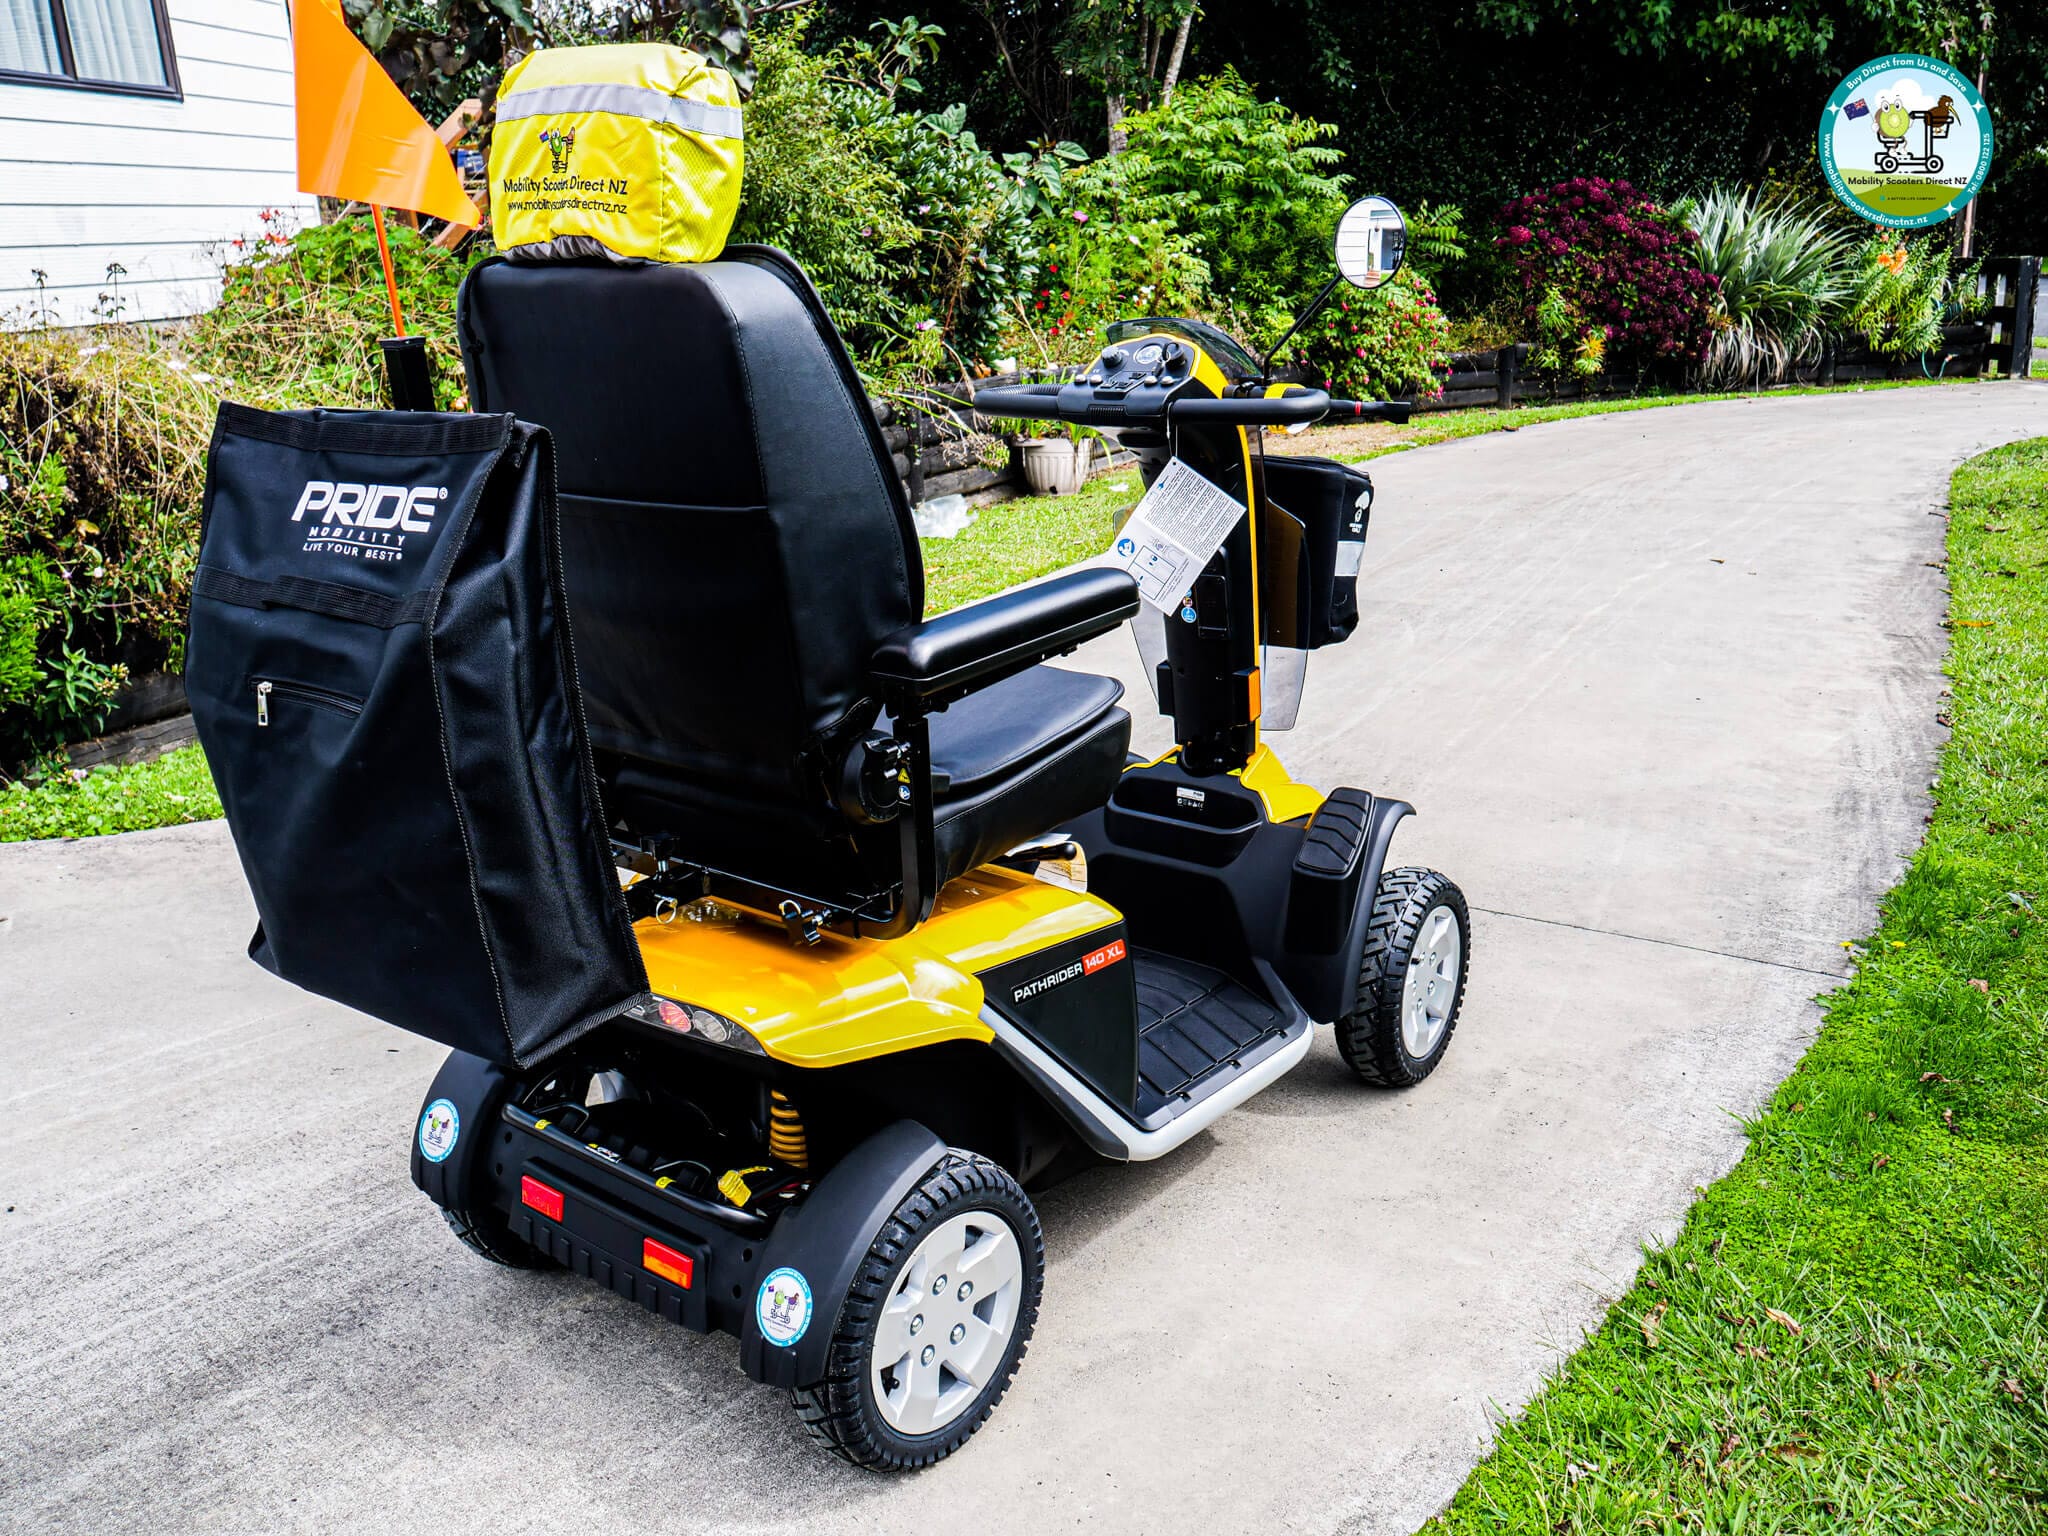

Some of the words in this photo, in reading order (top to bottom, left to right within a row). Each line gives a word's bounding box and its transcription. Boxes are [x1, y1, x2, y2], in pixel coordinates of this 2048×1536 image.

[503, 176, 541, 196] Mobility
[569, 175, 604, 193] Direct
[608, 179, 628, 195] NZ
[309, 527, 405, 546] MOBILITY
[303, 543, 323, 551] LIVE
[327, 543, 358, 557] YOUR
[1014, 962, 1083, 1002] PATHRIDER
[1085, 953, 1104, 969] 140
[1107, 945, 1123, 960] XL
